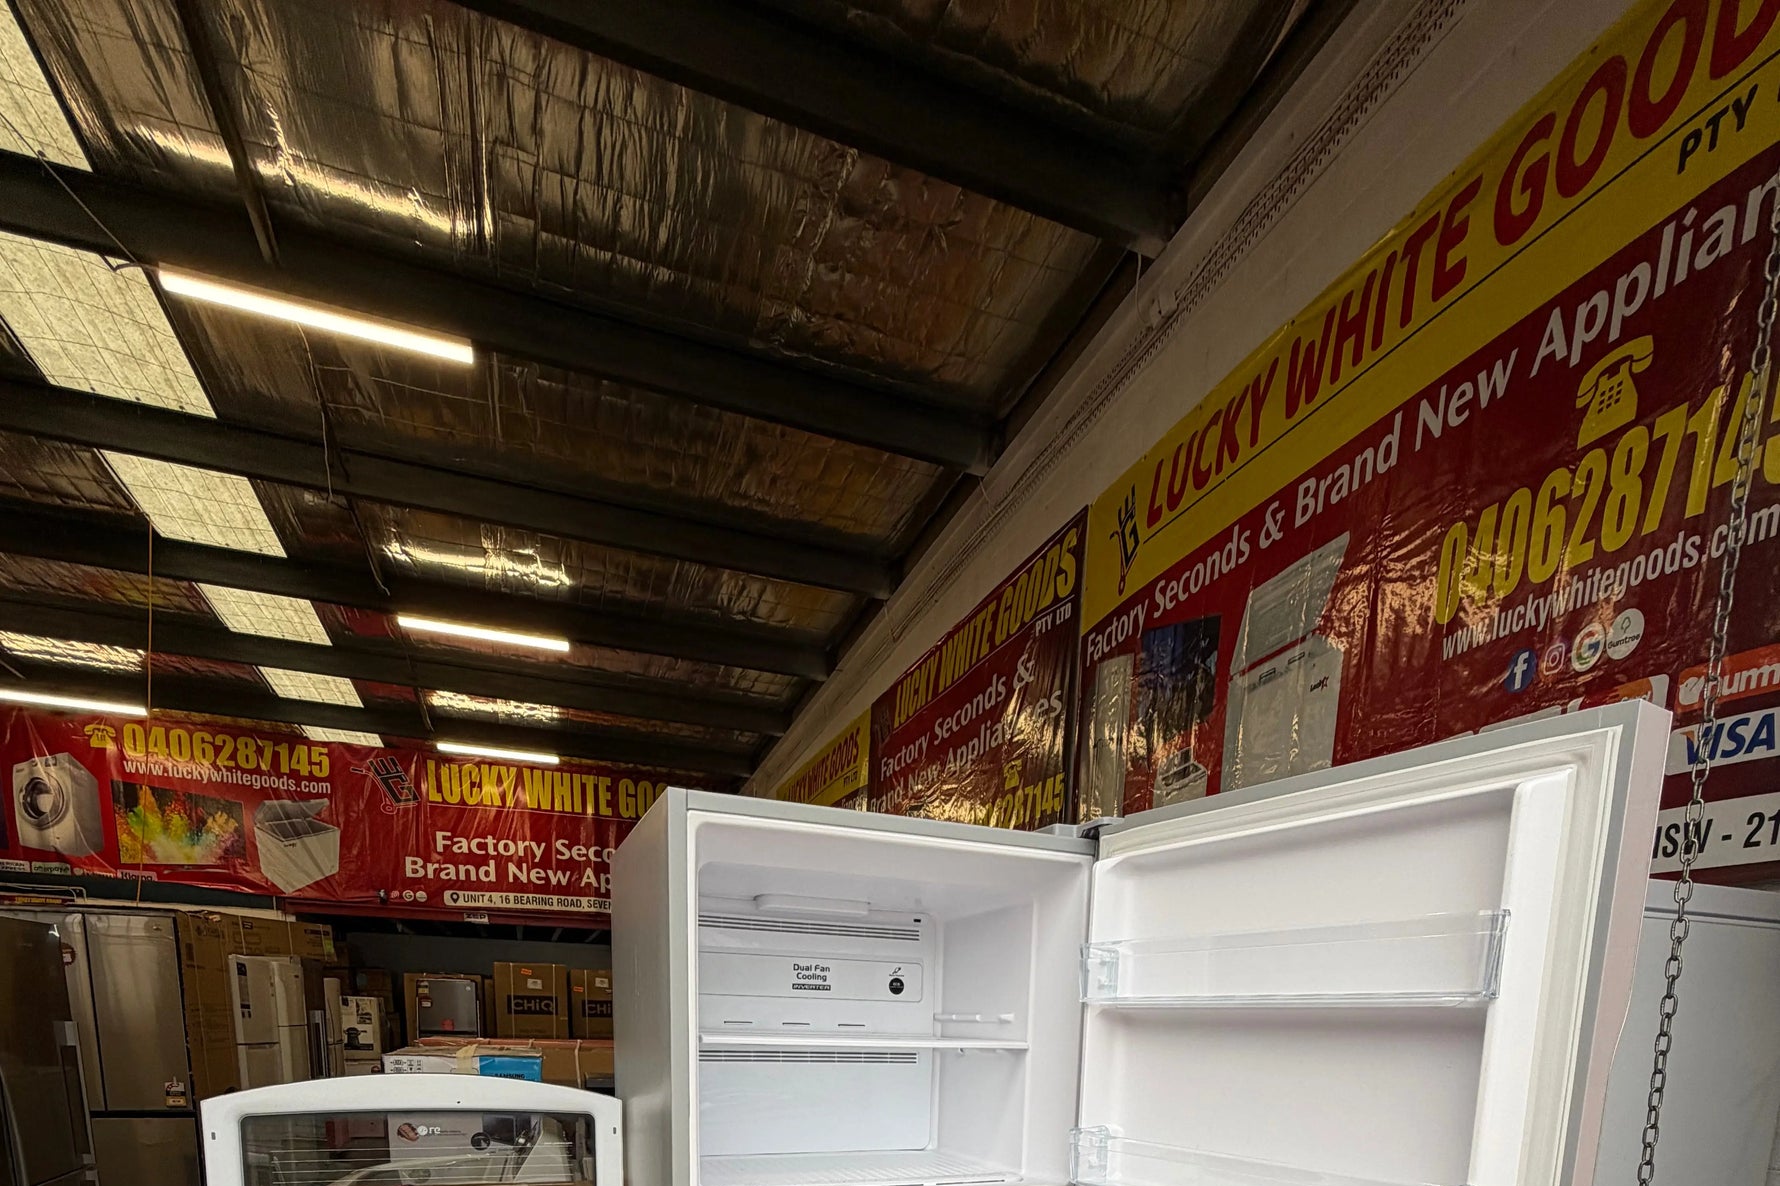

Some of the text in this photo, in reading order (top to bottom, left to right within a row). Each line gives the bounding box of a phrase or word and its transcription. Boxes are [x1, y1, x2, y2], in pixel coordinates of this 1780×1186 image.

[1677, 83, 1758, 175] PTY
[1145, 356, 1279, 529] LUCKY
[1285, 174, 1484, 419] WHITE
[1086, 599, 1149, 667] Factory
[1153, 525, 1251, 619] Seconds
[1259, 500, 1284, 549] &
[1295, 415, 1401, 529] Brand
[1415, 350, 1520, 451] New
[895, 527, 1078, 730] LUCKY WHITE GOODS
[1035, 602, 1072, 637] PTY LTD
[880, 652, 1035, 782] Factory Seconds &
[945, 688, 1063, 777] Appliaes
[1686, 713, 1775, 766] VISA
[122, 723, 330, 778] 0406287145
[123, 760, 331, 794] www.luckywhitegoods.com
[427, 759, 667, 819] LUCKY WHITE GO
[405, 856, 496, 882] Brand
[508, 865, 571, 887] New
[435, 831, 545, 862] Factory
[121, 871, 153, 881] Klana
[463, 893, 486, 904] UNIT
[500, 895, 510, 904] 16
[514, 895, 553, 907] BEARING
[793, 963, 831, 972] Dual Fan
[796, 972, 827, 983] Cooling
